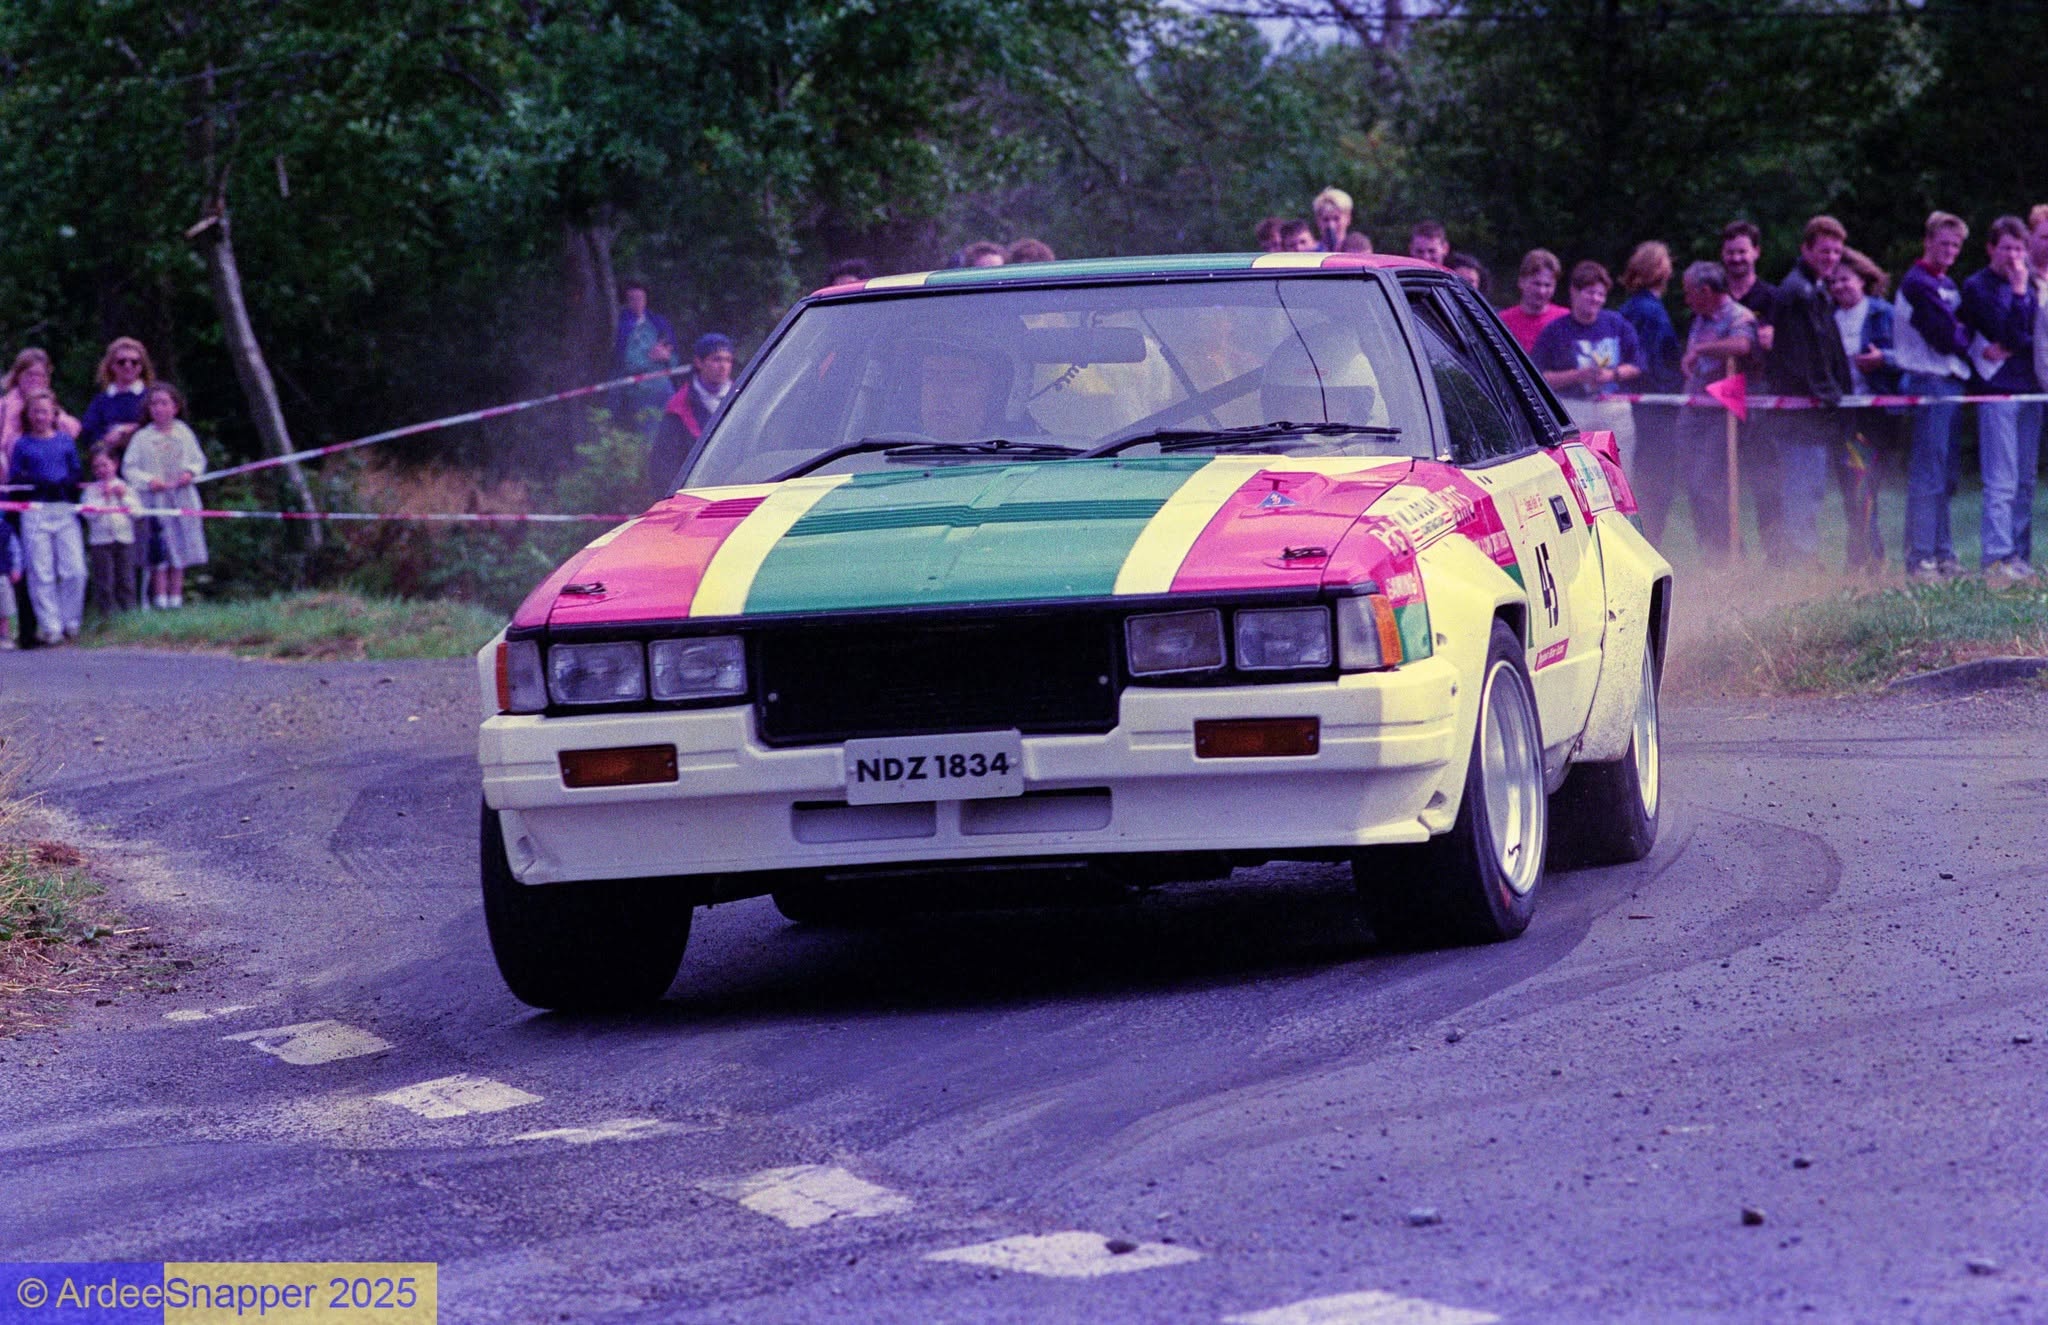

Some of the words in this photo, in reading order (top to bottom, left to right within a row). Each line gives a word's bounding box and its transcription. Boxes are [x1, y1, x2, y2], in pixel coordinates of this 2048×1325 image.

[1535, 542, 1559, 629] 45
[856, 756, 927, 783] NDZ
[934, 752, 1010, 779] 1834
